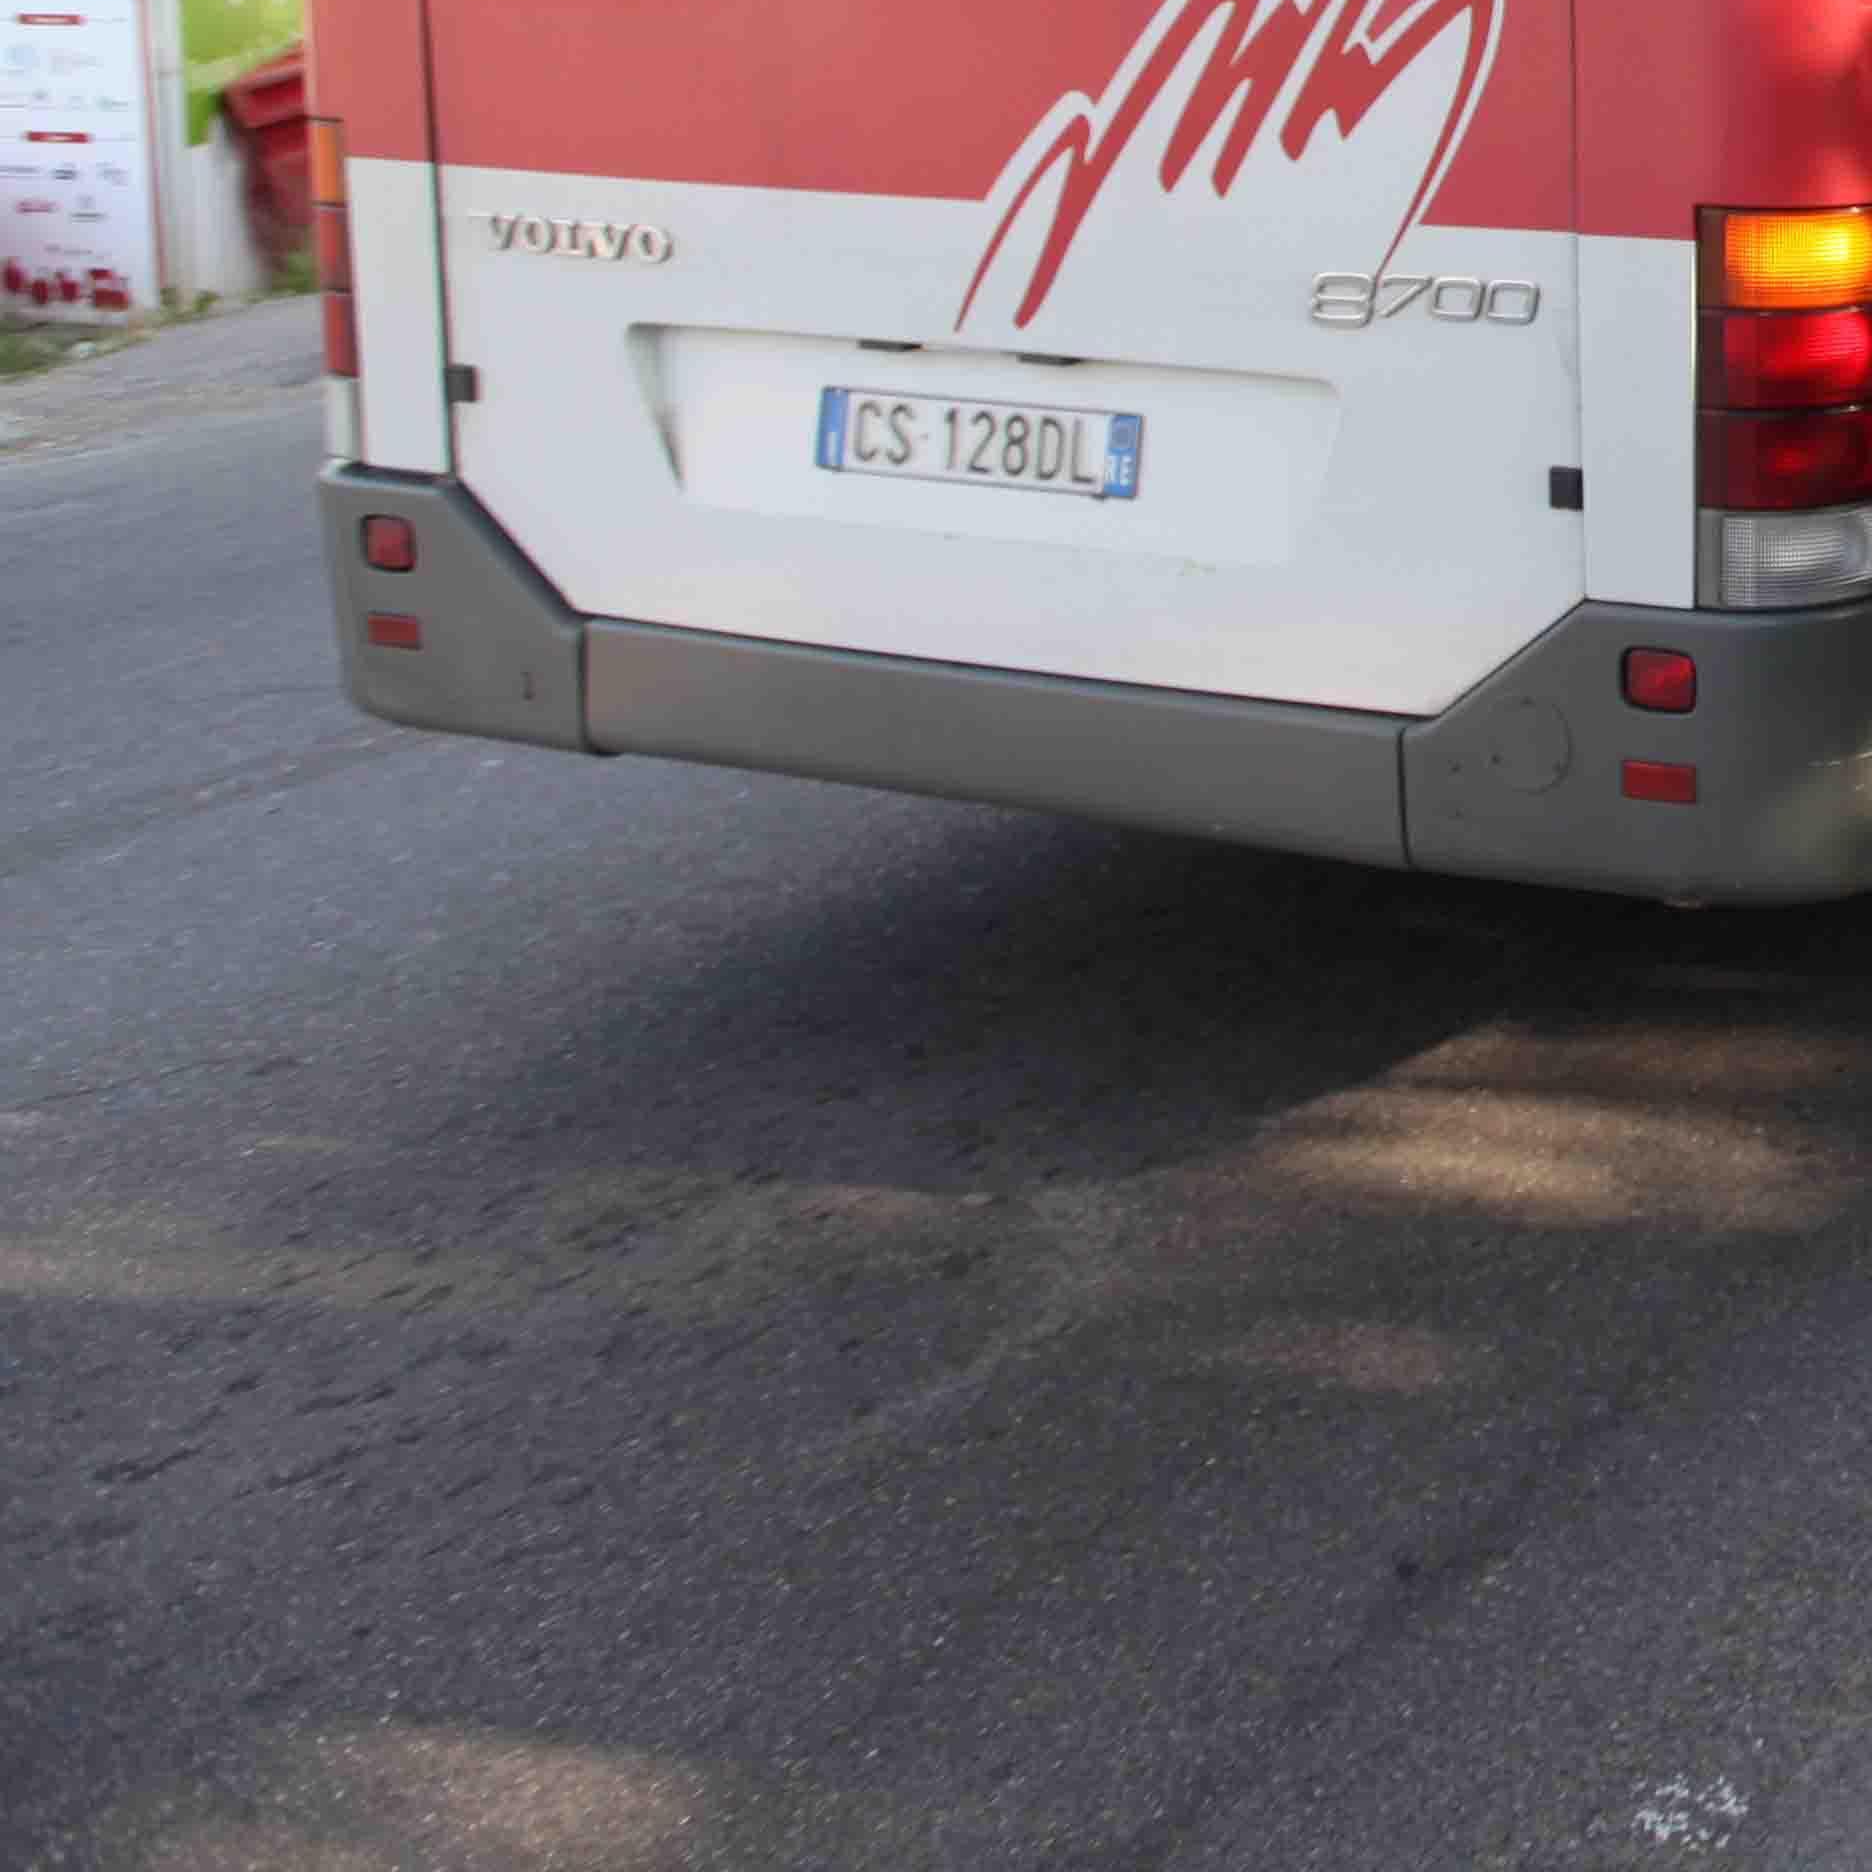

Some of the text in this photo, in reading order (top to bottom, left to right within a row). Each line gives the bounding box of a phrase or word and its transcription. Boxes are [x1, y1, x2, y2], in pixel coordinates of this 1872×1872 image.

[490, 212, 676, 265] VOLVO
[1309, 271, 1541, 329] 8700
[853, 400, 915, 466] CS
[944, 406, 1095, 485] 128DL
